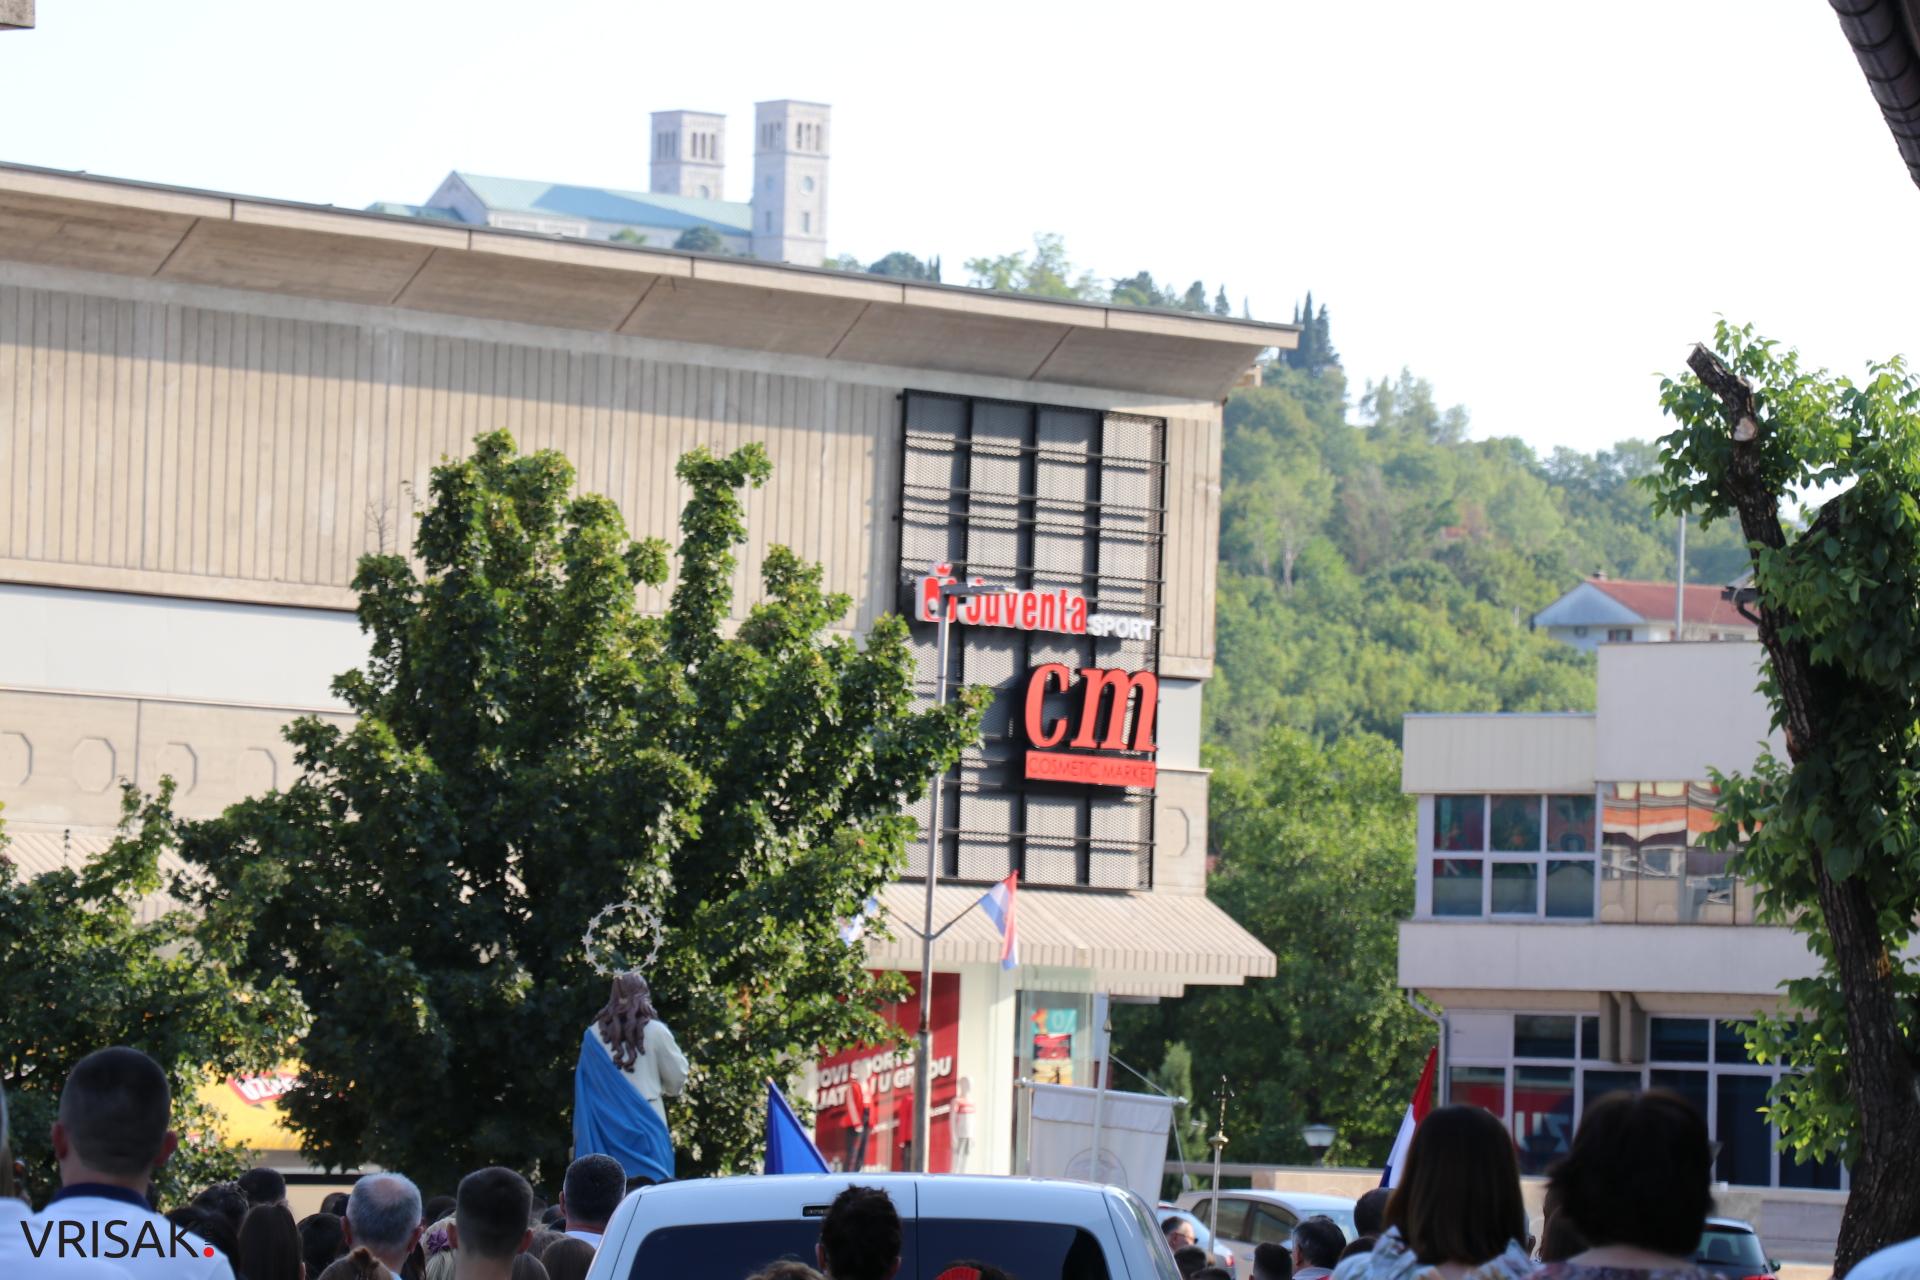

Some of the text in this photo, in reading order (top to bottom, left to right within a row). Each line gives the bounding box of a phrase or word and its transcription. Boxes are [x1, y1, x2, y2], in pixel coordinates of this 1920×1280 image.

[1089, 614, 1155, 641] SPORT
[1028, 756, 1155, 784] COSMETIC MARKET
[893, 1055, 952, 1088] GRDU
